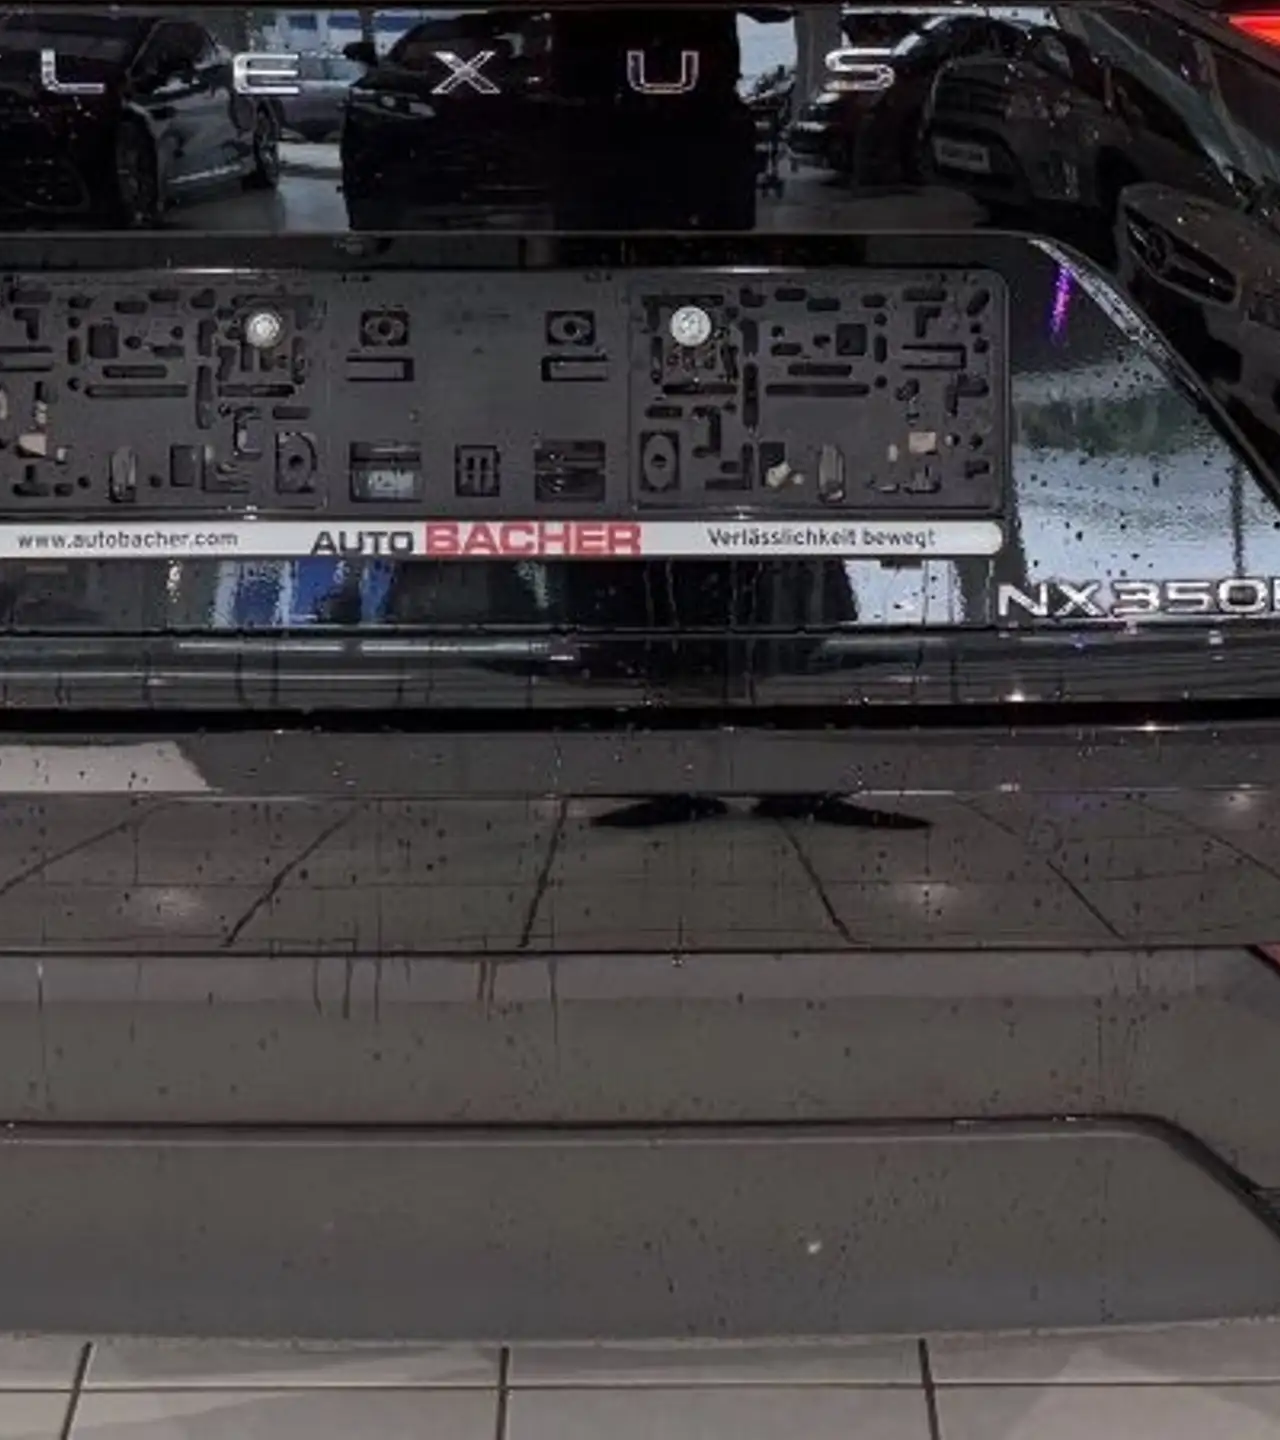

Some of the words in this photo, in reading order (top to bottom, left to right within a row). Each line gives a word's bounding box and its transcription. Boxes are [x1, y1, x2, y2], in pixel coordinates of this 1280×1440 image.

[40, 49, 898, 96] LEXUS
[17, 530, 238, 552] www.autobacher.com
[312, 530, 415, 555] AUTO
[424, 523, 641, 557] BACHER
[707, 526, 857, 549] Verlässlichkeit
[863, 527, 934, 553] bewegt
